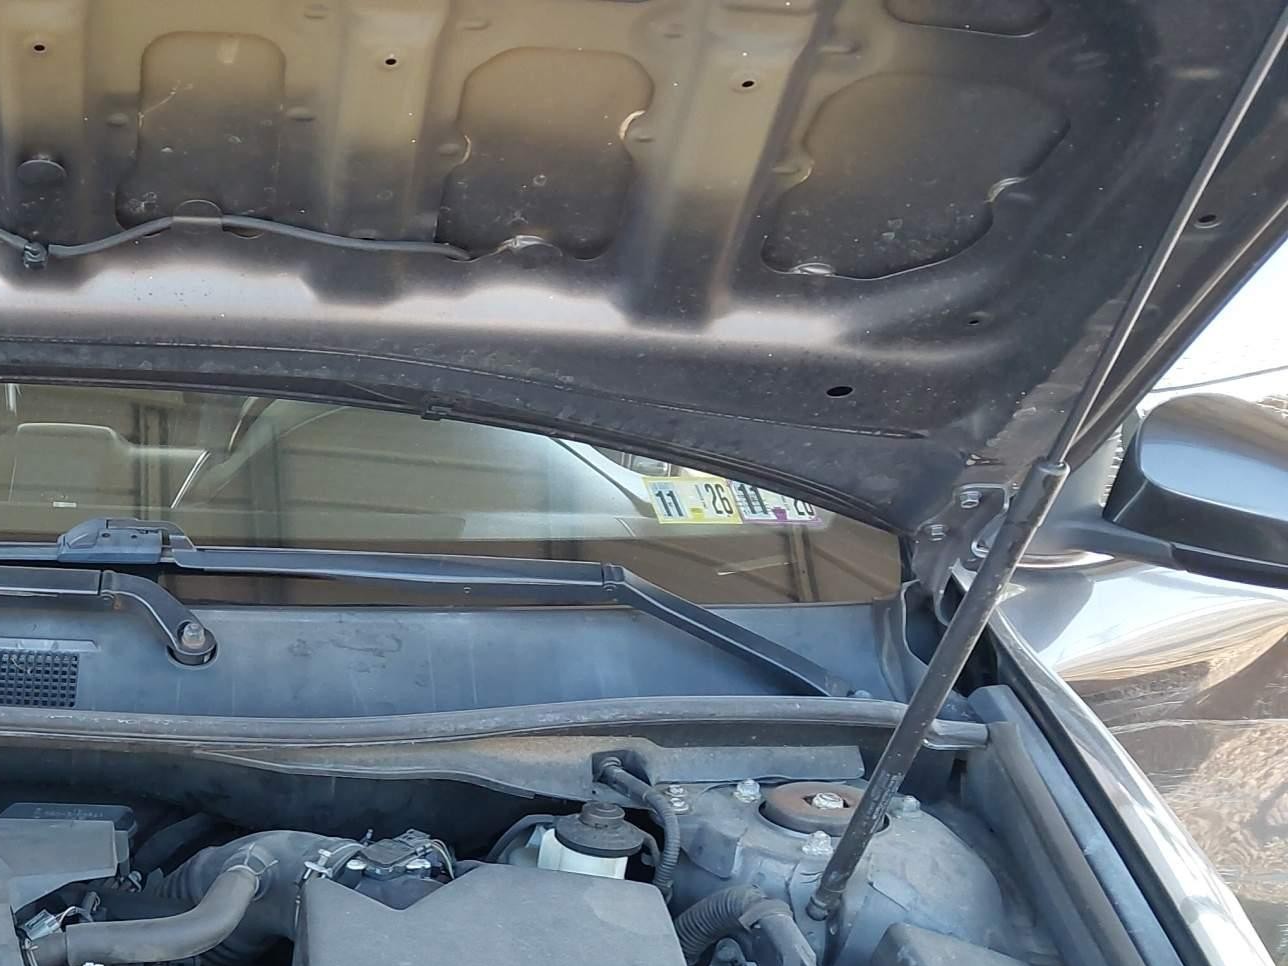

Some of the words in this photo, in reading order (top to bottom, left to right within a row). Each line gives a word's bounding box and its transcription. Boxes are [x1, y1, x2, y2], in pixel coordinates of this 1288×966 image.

[655, 489, 684, 517] 11
[705, 483, 733, 515] 26
[737, 484, 769, 515] 11
